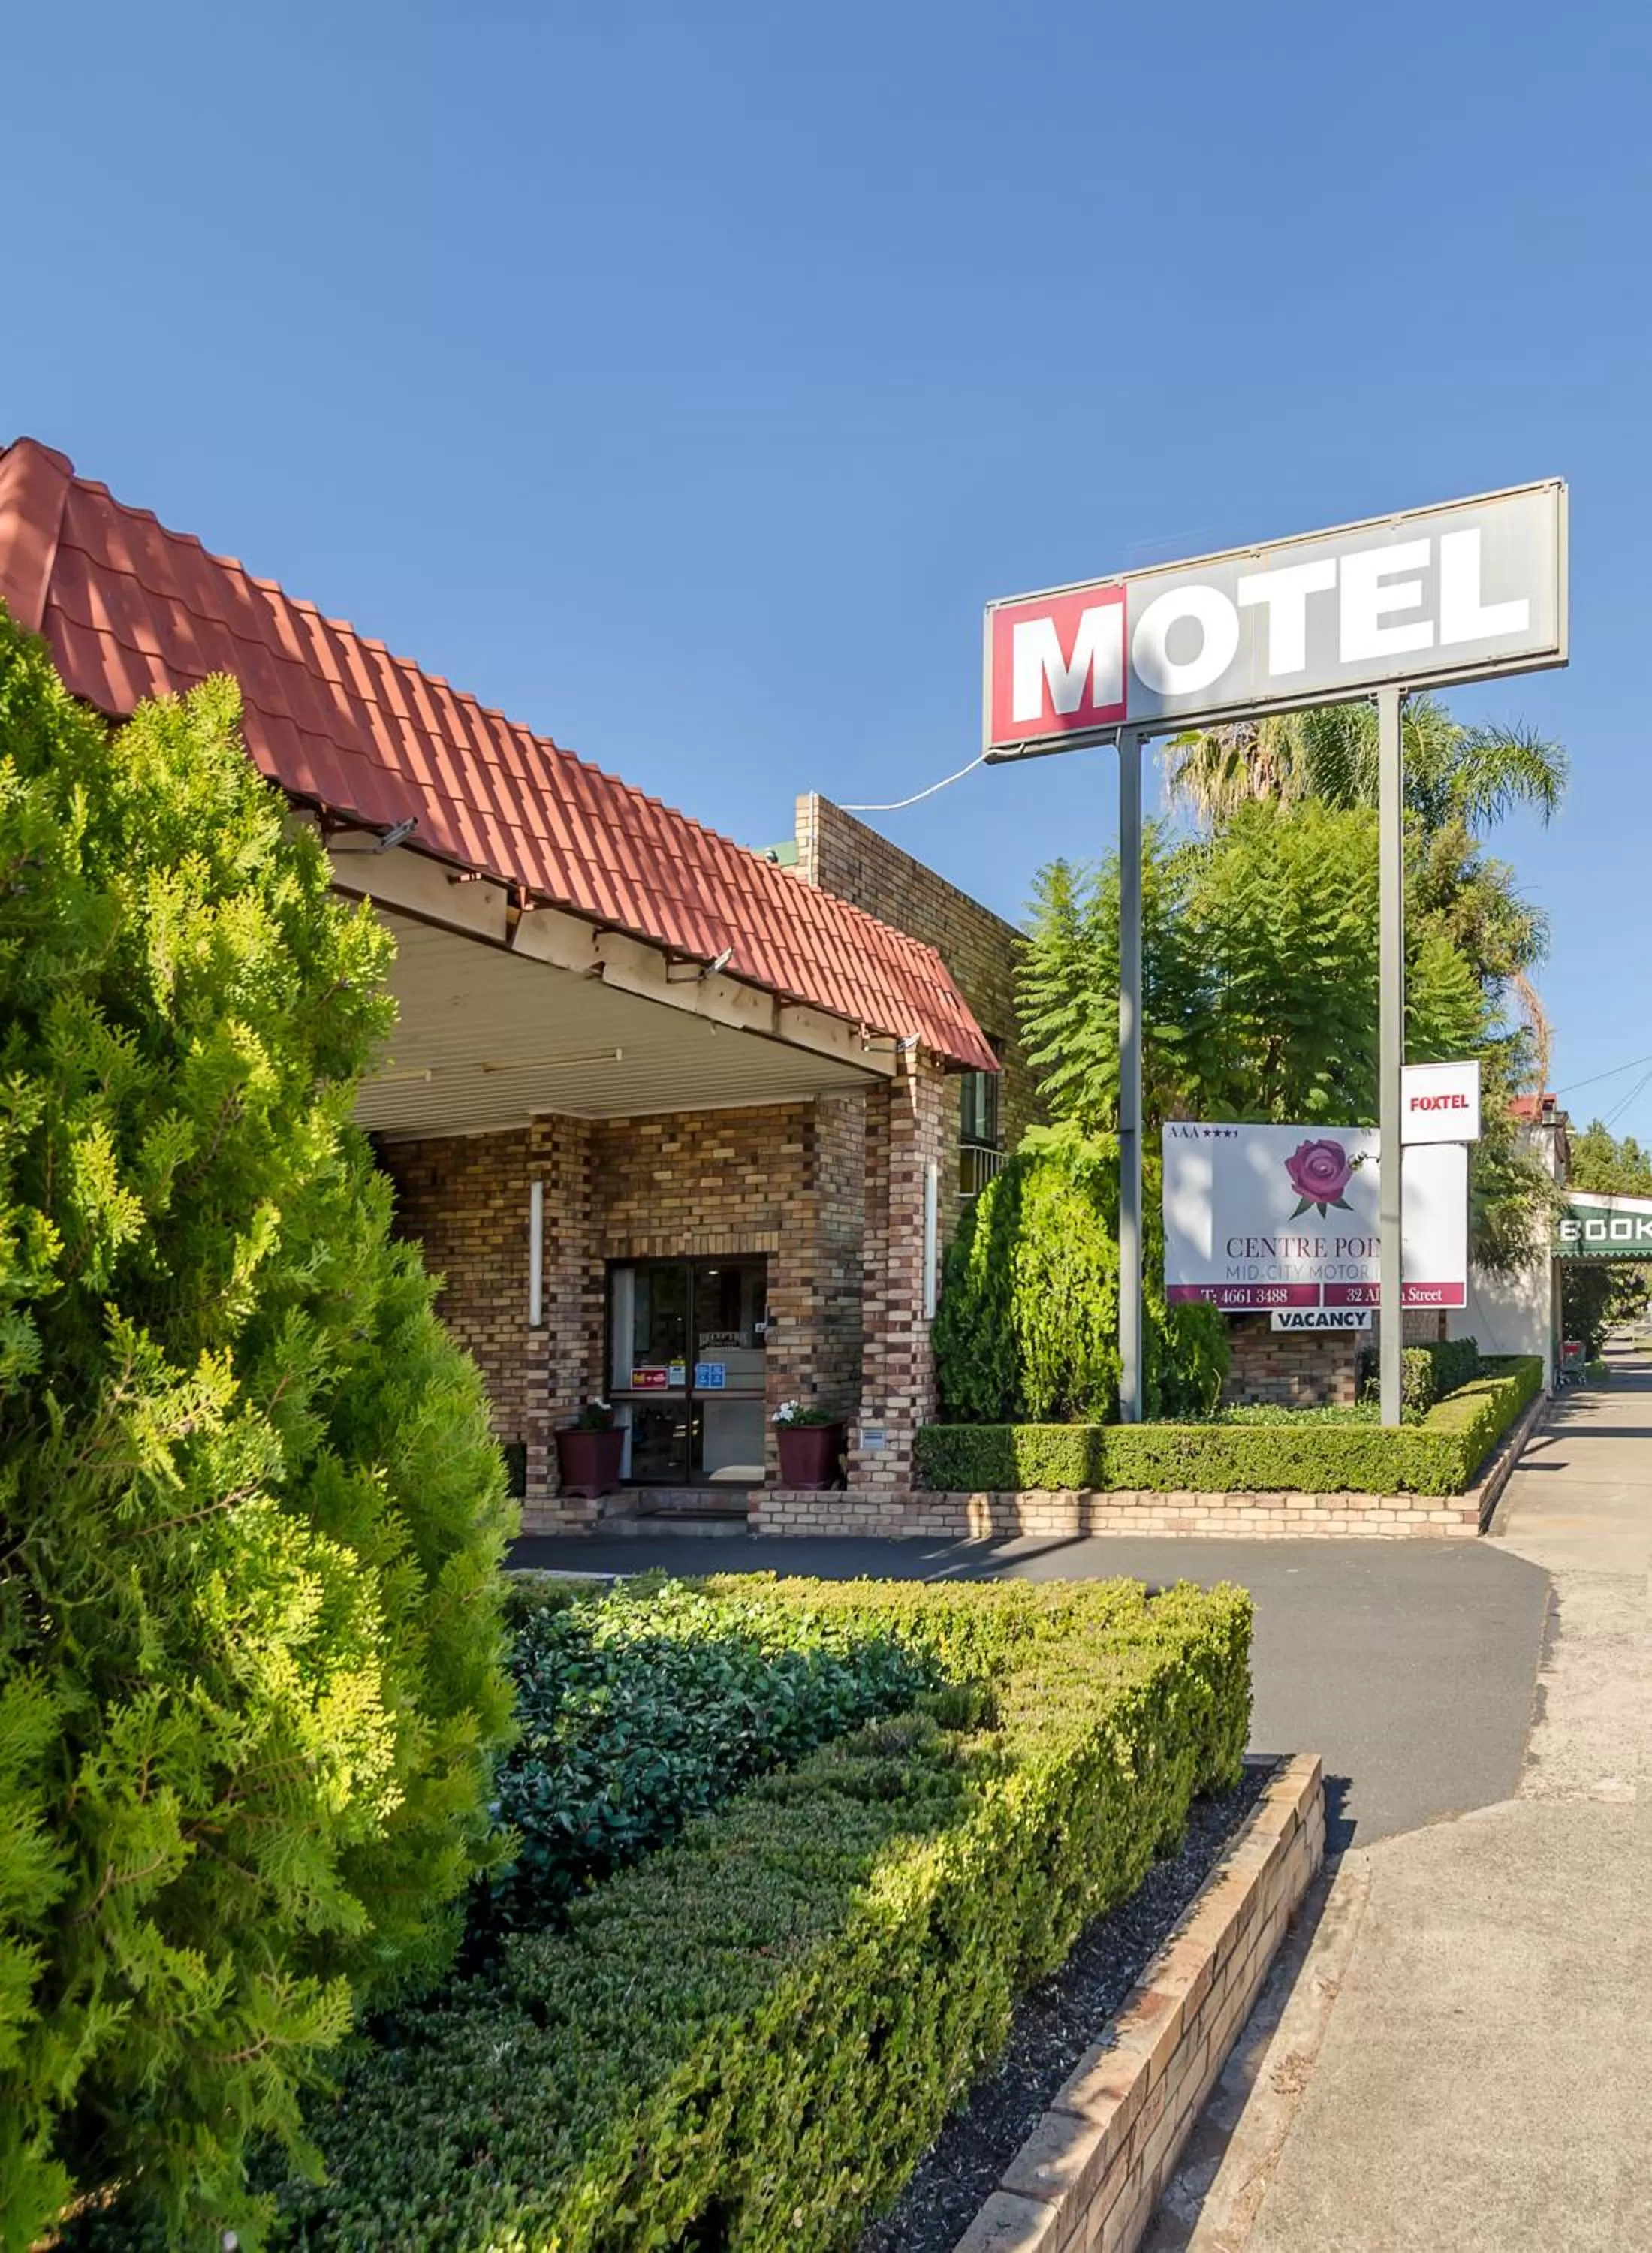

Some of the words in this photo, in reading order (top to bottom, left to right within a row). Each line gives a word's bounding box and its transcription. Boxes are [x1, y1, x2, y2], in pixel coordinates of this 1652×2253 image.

[1012, 528, 1529, 722] MOTEL
[1410, 1094, 1470, 1112] FOXTEL
[1168, 1126, 1200, 1138] AAA
[1226, 1237, 1327, 1258] CENTRE
[1334, 1237, 1409, 1258] POI
[1310, 1264, 1368, 1280] MOTOR
[1201, 1289, 1217, 1303] T:
[1221, 1289, 1250, 1303] 4661
[1256, 1289, 1288, 1303] 3488
[1346, 1288, 1362, 1302] 32
[1409, 1287, 1442, 1301] Street
[1278, 1312, 1367, 1327] VACANCY
